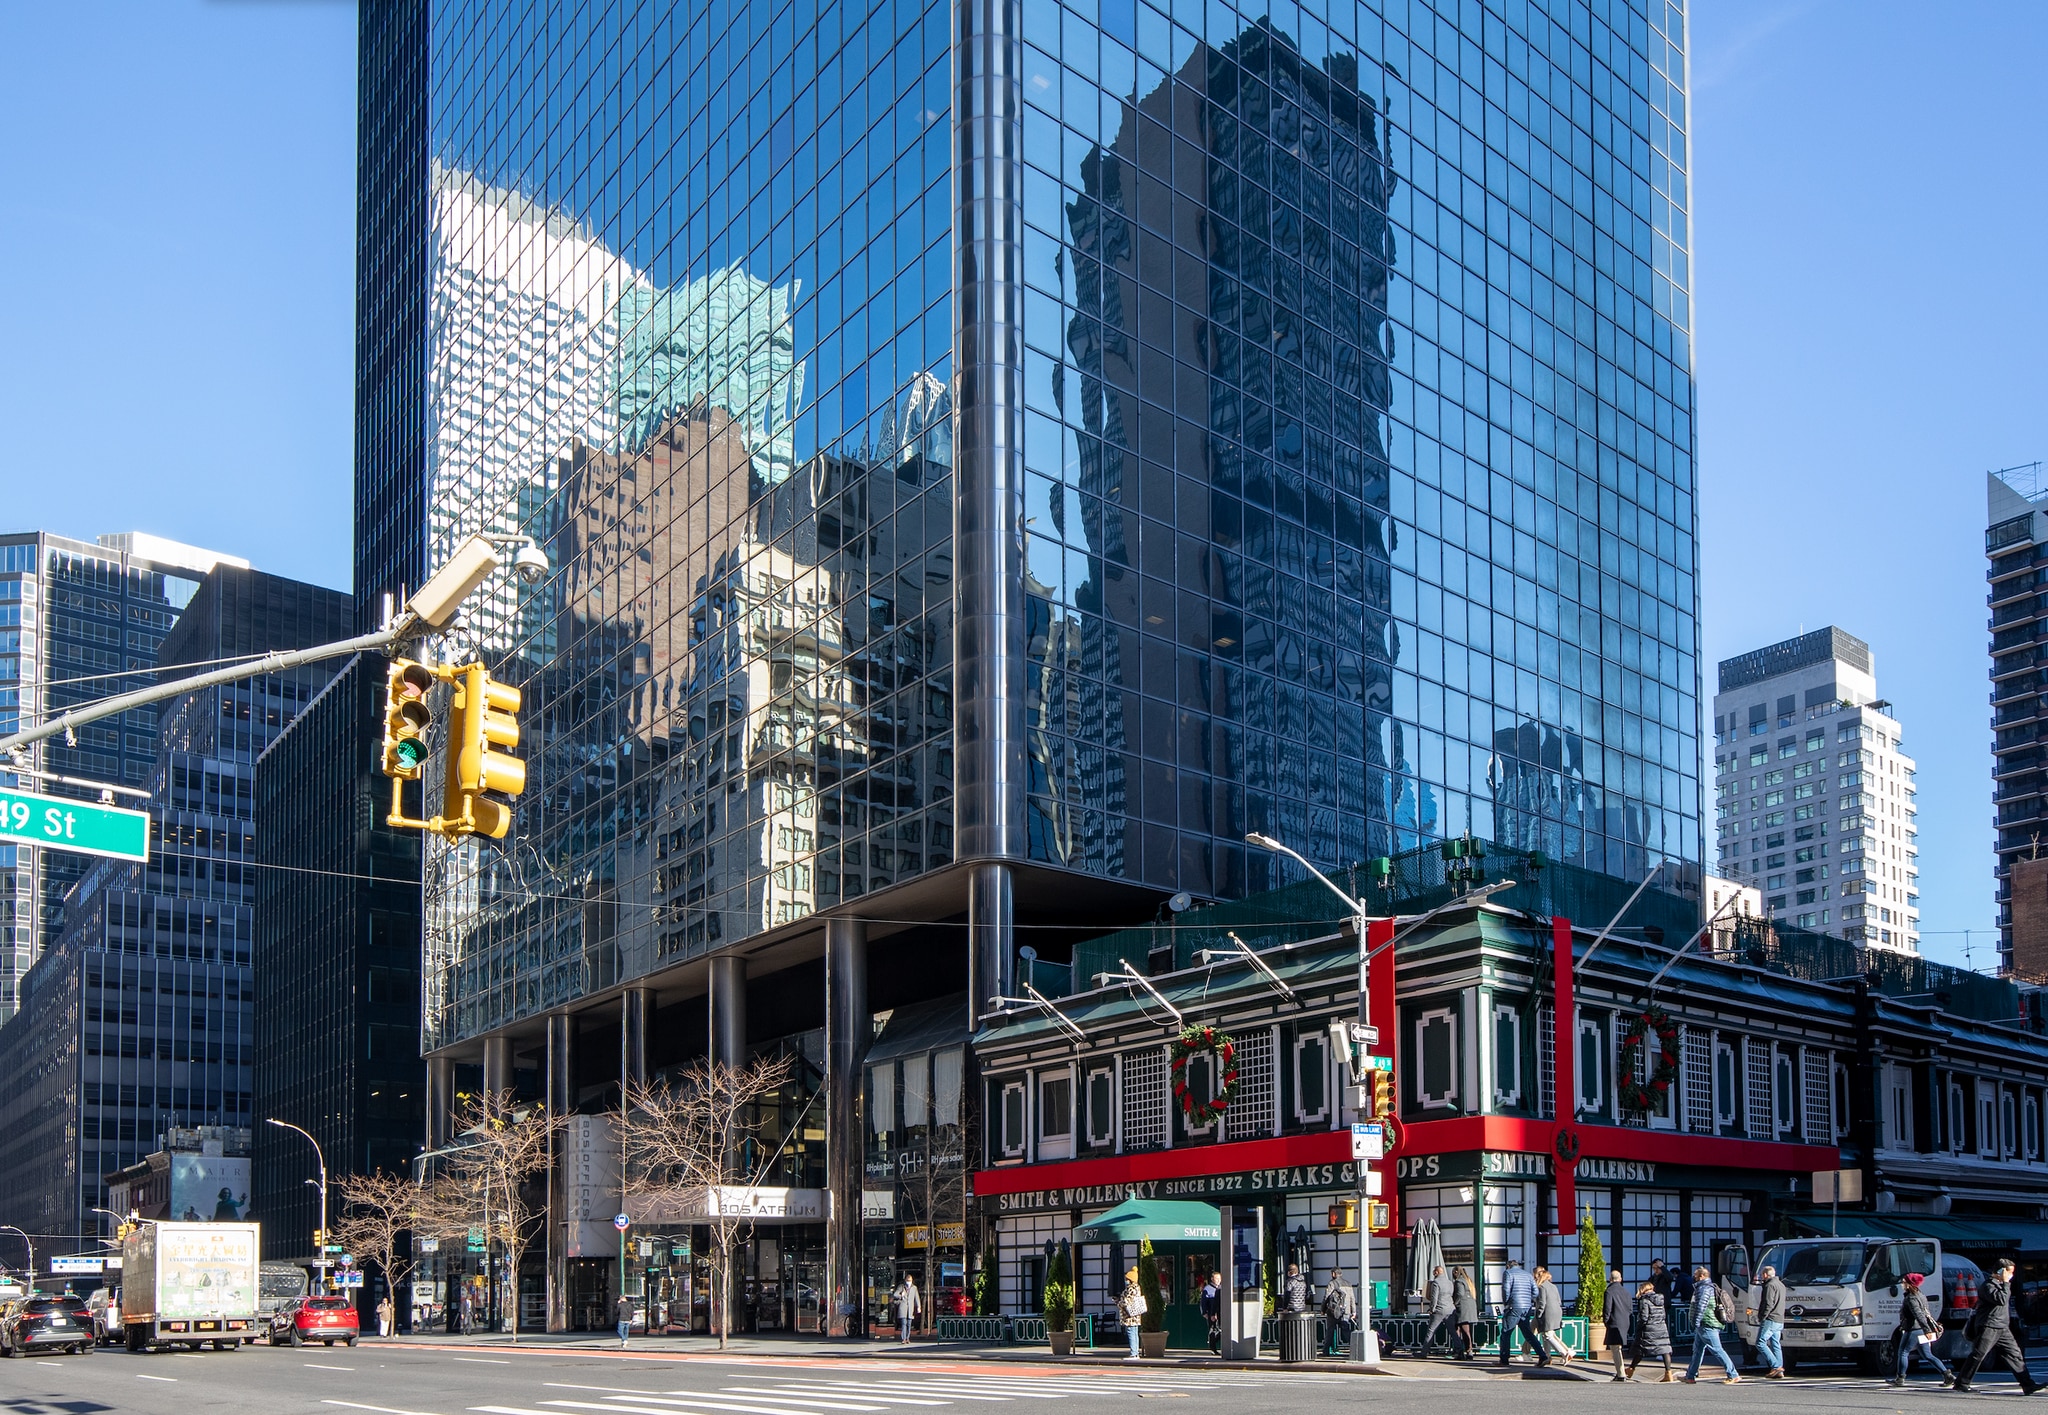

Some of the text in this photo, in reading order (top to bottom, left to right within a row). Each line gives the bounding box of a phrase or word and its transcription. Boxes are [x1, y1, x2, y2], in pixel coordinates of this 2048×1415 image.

[43, 807, 77, 839] St
[1490, 1152, 1546, 1176] SMITH
[1573, 1158, 1656, 1182] OLLENSKY
[1000, 1155, 1440, 1211] SMITH & WOLLENSKY SINCE 1977 STEAKS & OPS
[758, 1205, 817, 1216] ATRIUM
[1083, 1228, 1099, 1240] 797
[1184, 1227, 1219, 1238] SMITH &
